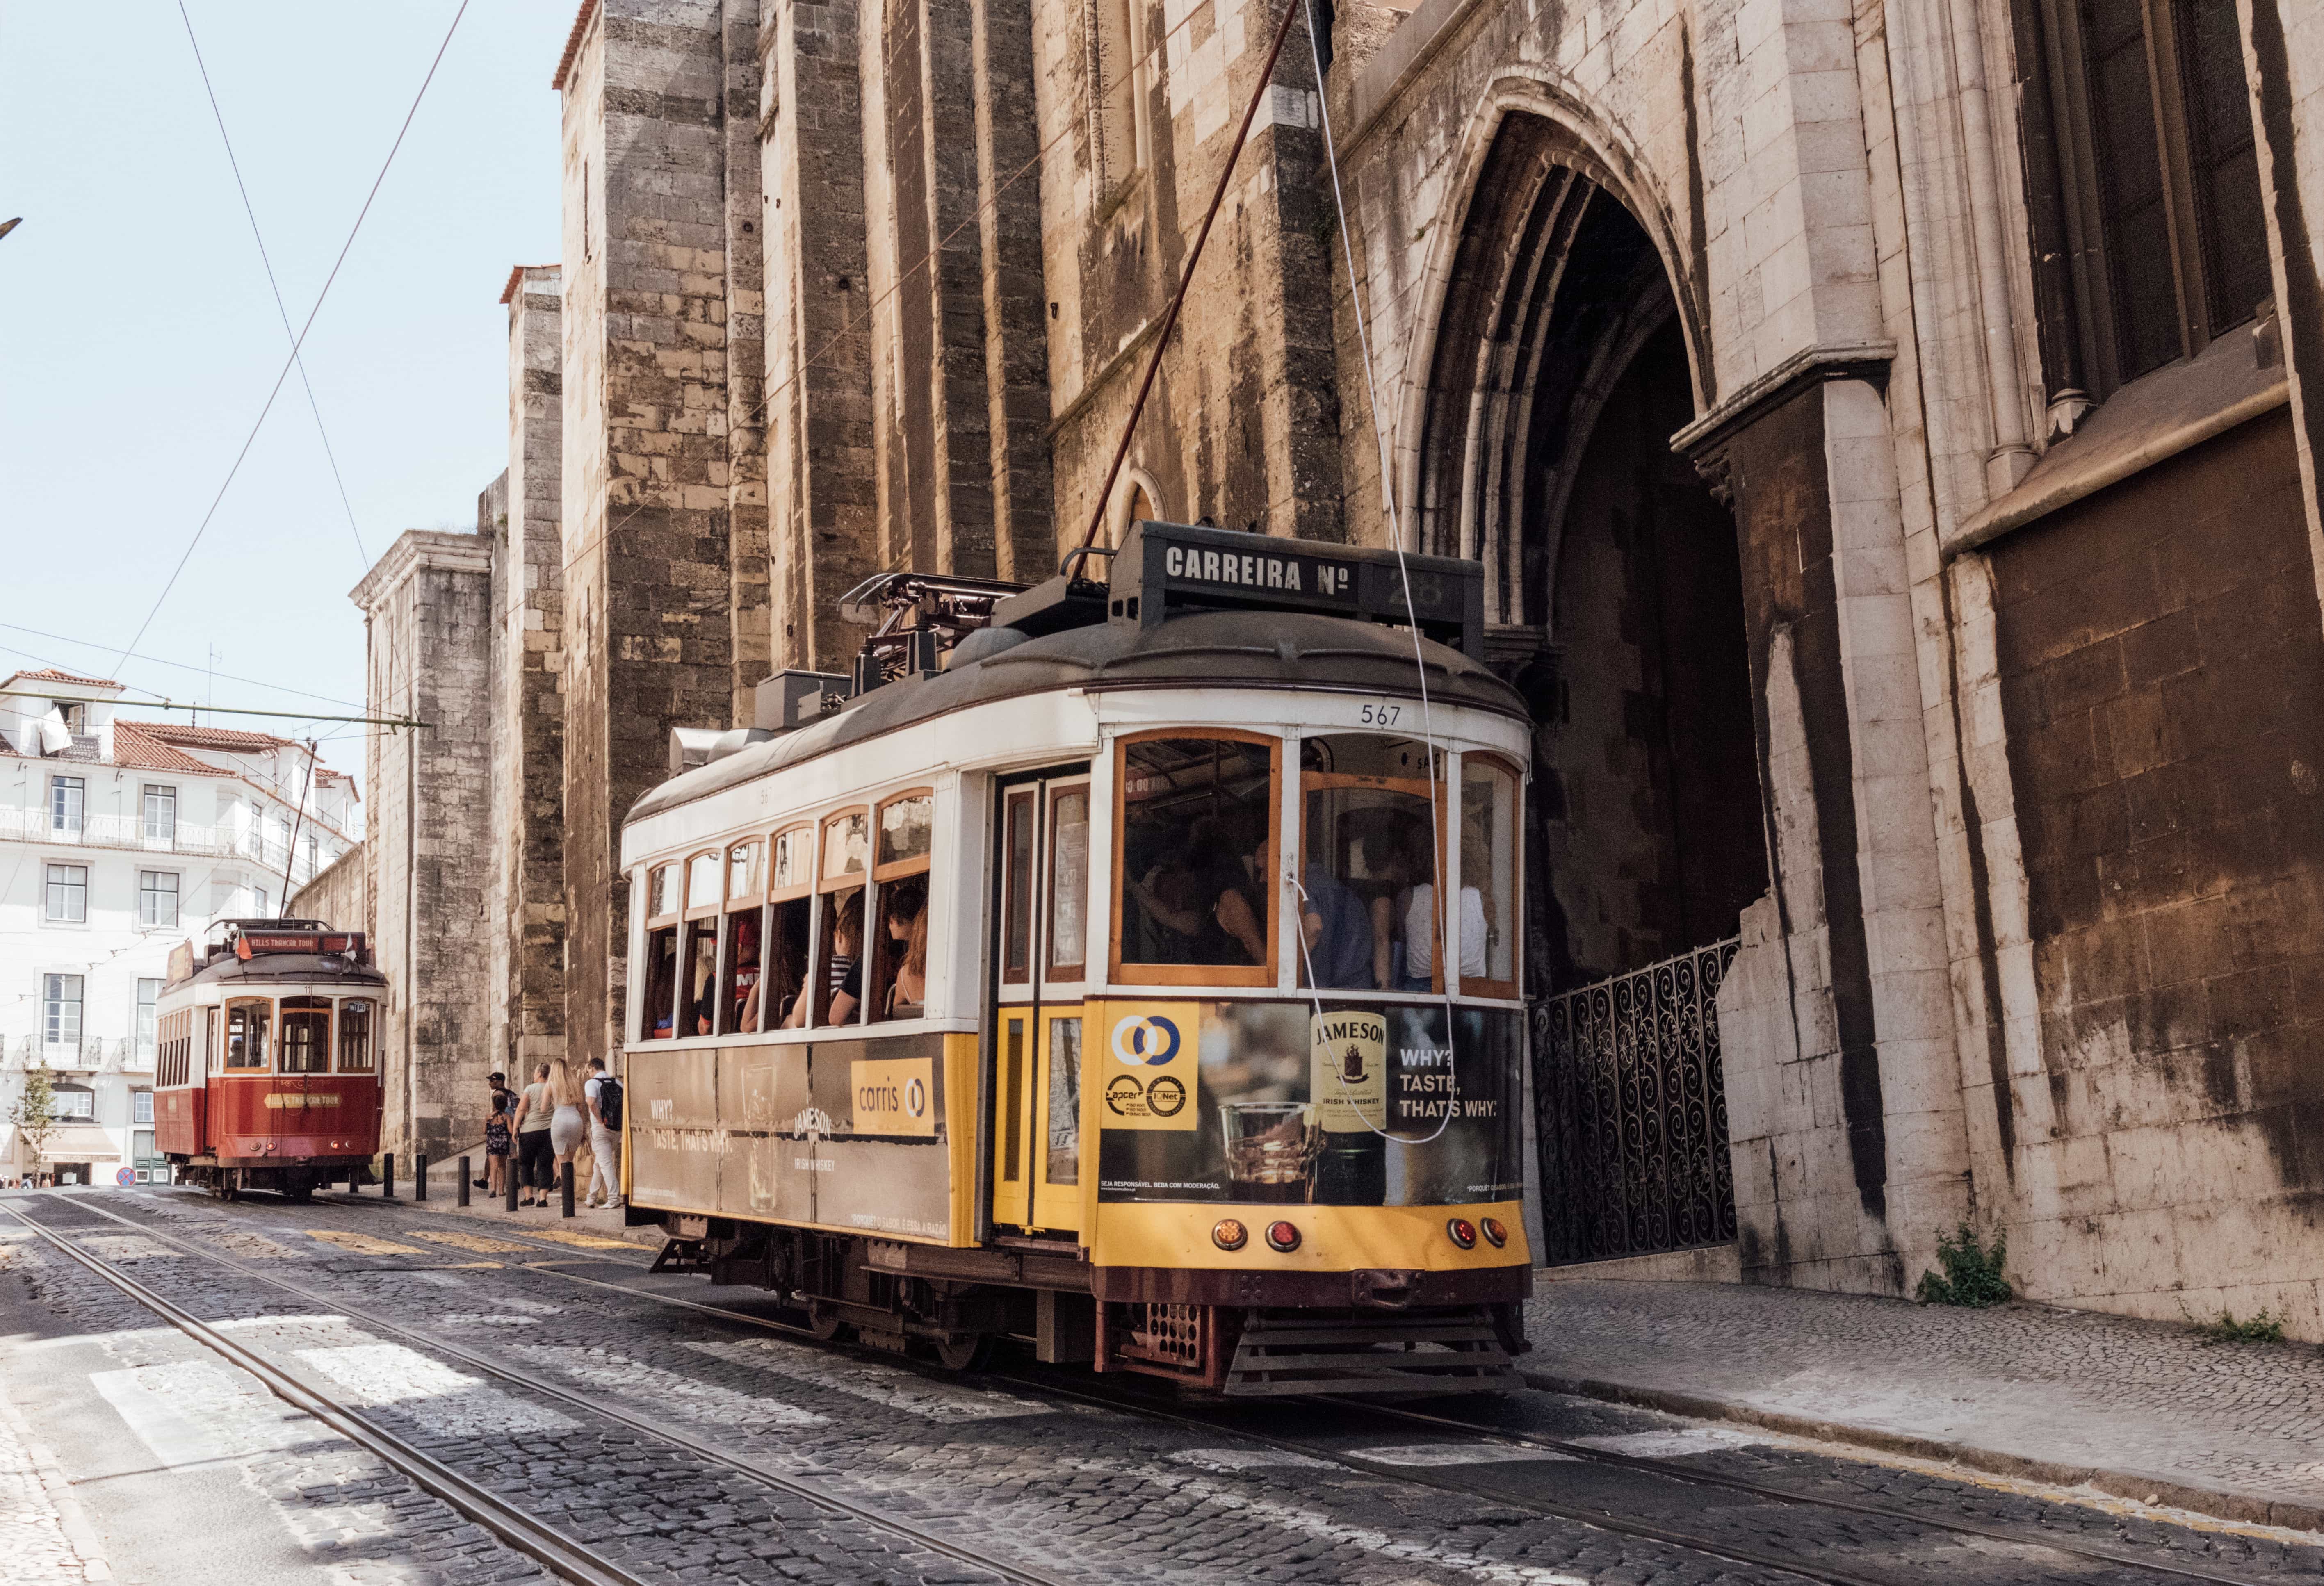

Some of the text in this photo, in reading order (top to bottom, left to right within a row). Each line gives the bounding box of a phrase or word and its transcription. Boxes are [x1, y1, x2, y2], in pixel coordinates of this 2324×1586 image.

[1166, 547, 1301, 590] CARREIRA
[1361, 704, 1400, 725] 567
[1316, 1022, 1384, 1046] JAMESON
[1400, 1049, 1452, 1066] WHY?
[859, 1076, 898, 1112] carris
[1400, 1074, 1460, 1095] TASTE,
[322, 1096, 338, 1104] TOUR
[1113, 1092, 1137, 1101] apcer
[651, 1099, 673, 1120] WHY?
[794, 1107, 832, 1139] JAMESON
[652, 1130, 679, 1154] TASTE,
[680, 1130, 708, 1152] THAT'S
[794, 1158, 835, 1171] IRISH WHISKEY
[877, 1217, 881, 1227] O
[907, 1219, 920, 1232] ESSA
[922, 1221, 926, 1233] A
